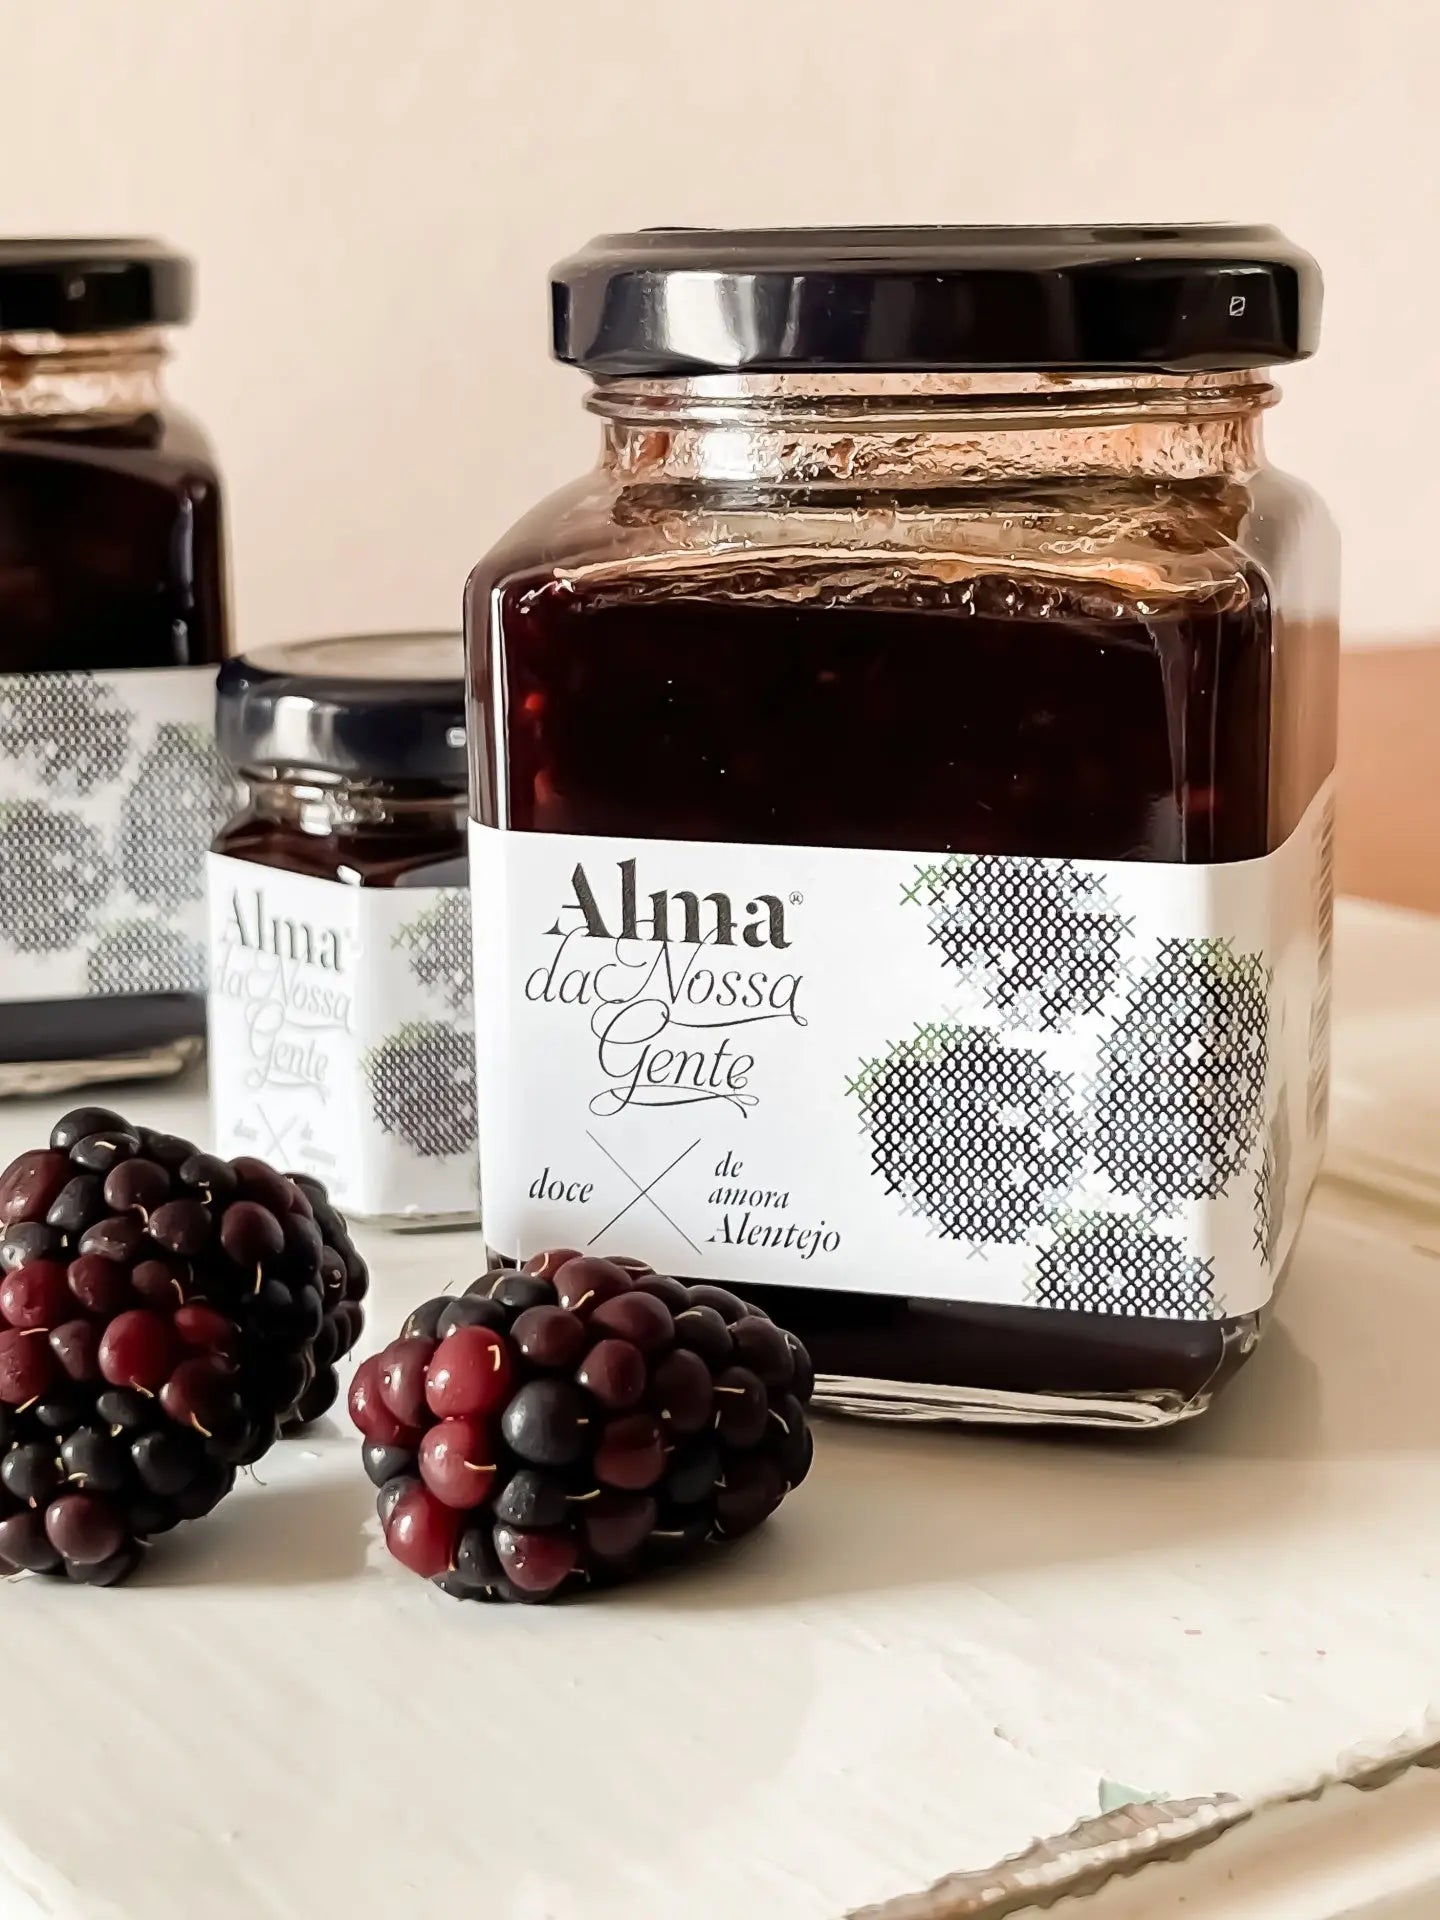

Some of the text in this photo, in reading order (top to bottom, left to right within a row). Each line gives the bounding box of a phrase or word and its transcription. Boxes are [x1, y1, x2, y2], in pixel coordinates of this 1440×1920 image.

[525, 922, 808, 1028] da Nossa
[245, 998, 331, 1104] Gente
[588, 999, 759, 1119] Gente
[528, 1167, 594, 1204] doce
[714, 1151, 744, 1178] de
[708, 1185, 790, 1209] amora
[705, 1213, 841, 1260] Alentejo
